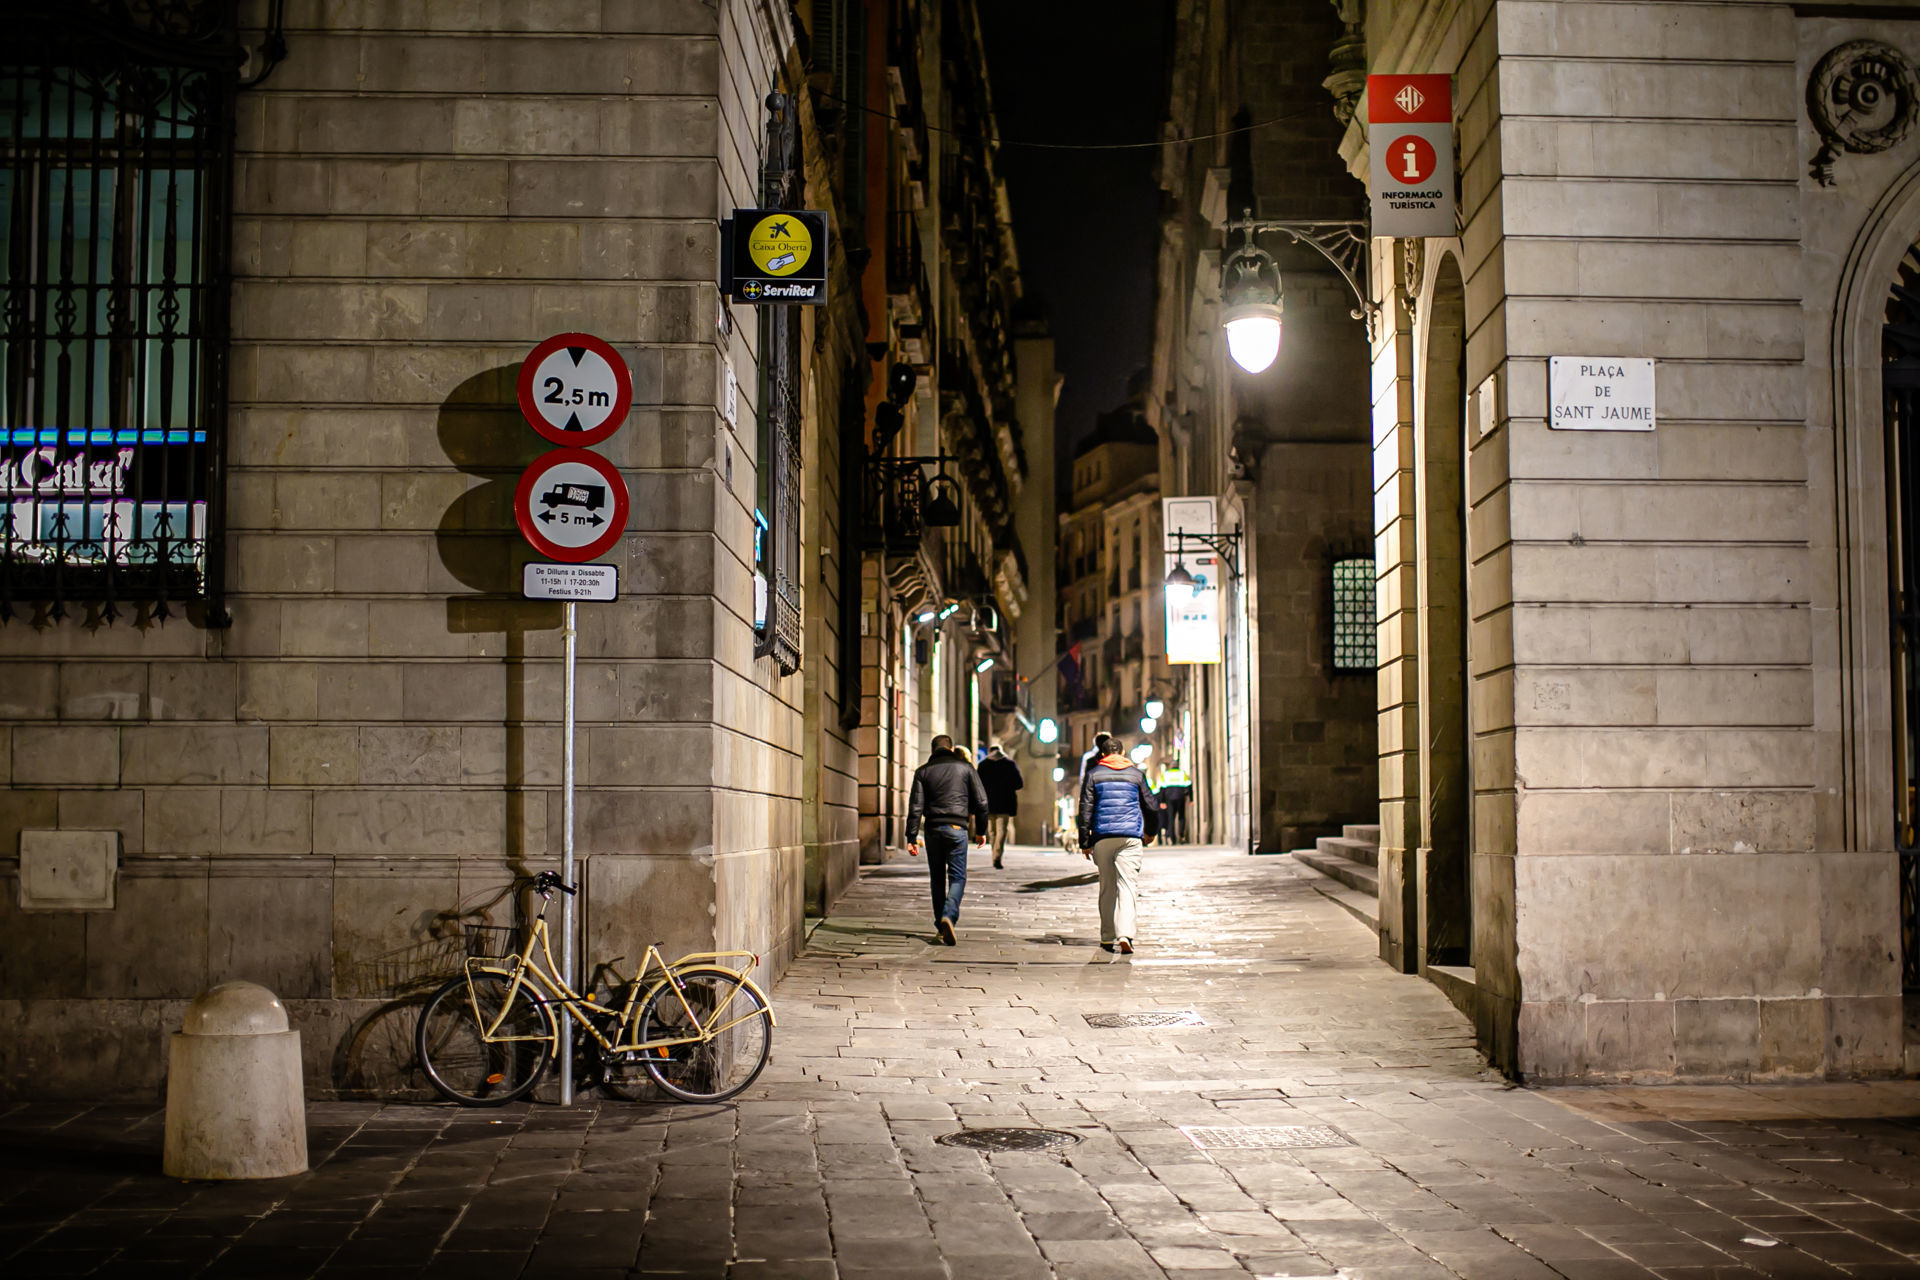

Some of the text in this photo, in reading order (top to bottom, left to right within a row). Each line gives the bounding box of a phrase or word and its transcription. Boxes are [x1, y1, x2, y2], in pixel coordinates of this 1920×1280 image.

[1382, 189, 1443, 200] INFORMACIÓ
[1389, 199, 1436, 209] TURÍSTICA
[752, 242, 807, 251] Caixa Oberta
[763, 284, 816, 297] ServiRed
[1580, 365, 1625, 379] PLAÇA
[1595, 386, 1611, 397] DE
[1554, 405, 1652, 420] SANT JAUME
[560, 512, 585, 525] 5 m
[536, 567, 545, 575] De
[547, 568, 569, 576] Dilluns
[578, 569, 605, 577] Dissabte
[548, 587, 592, 596] Festius 9-21h
